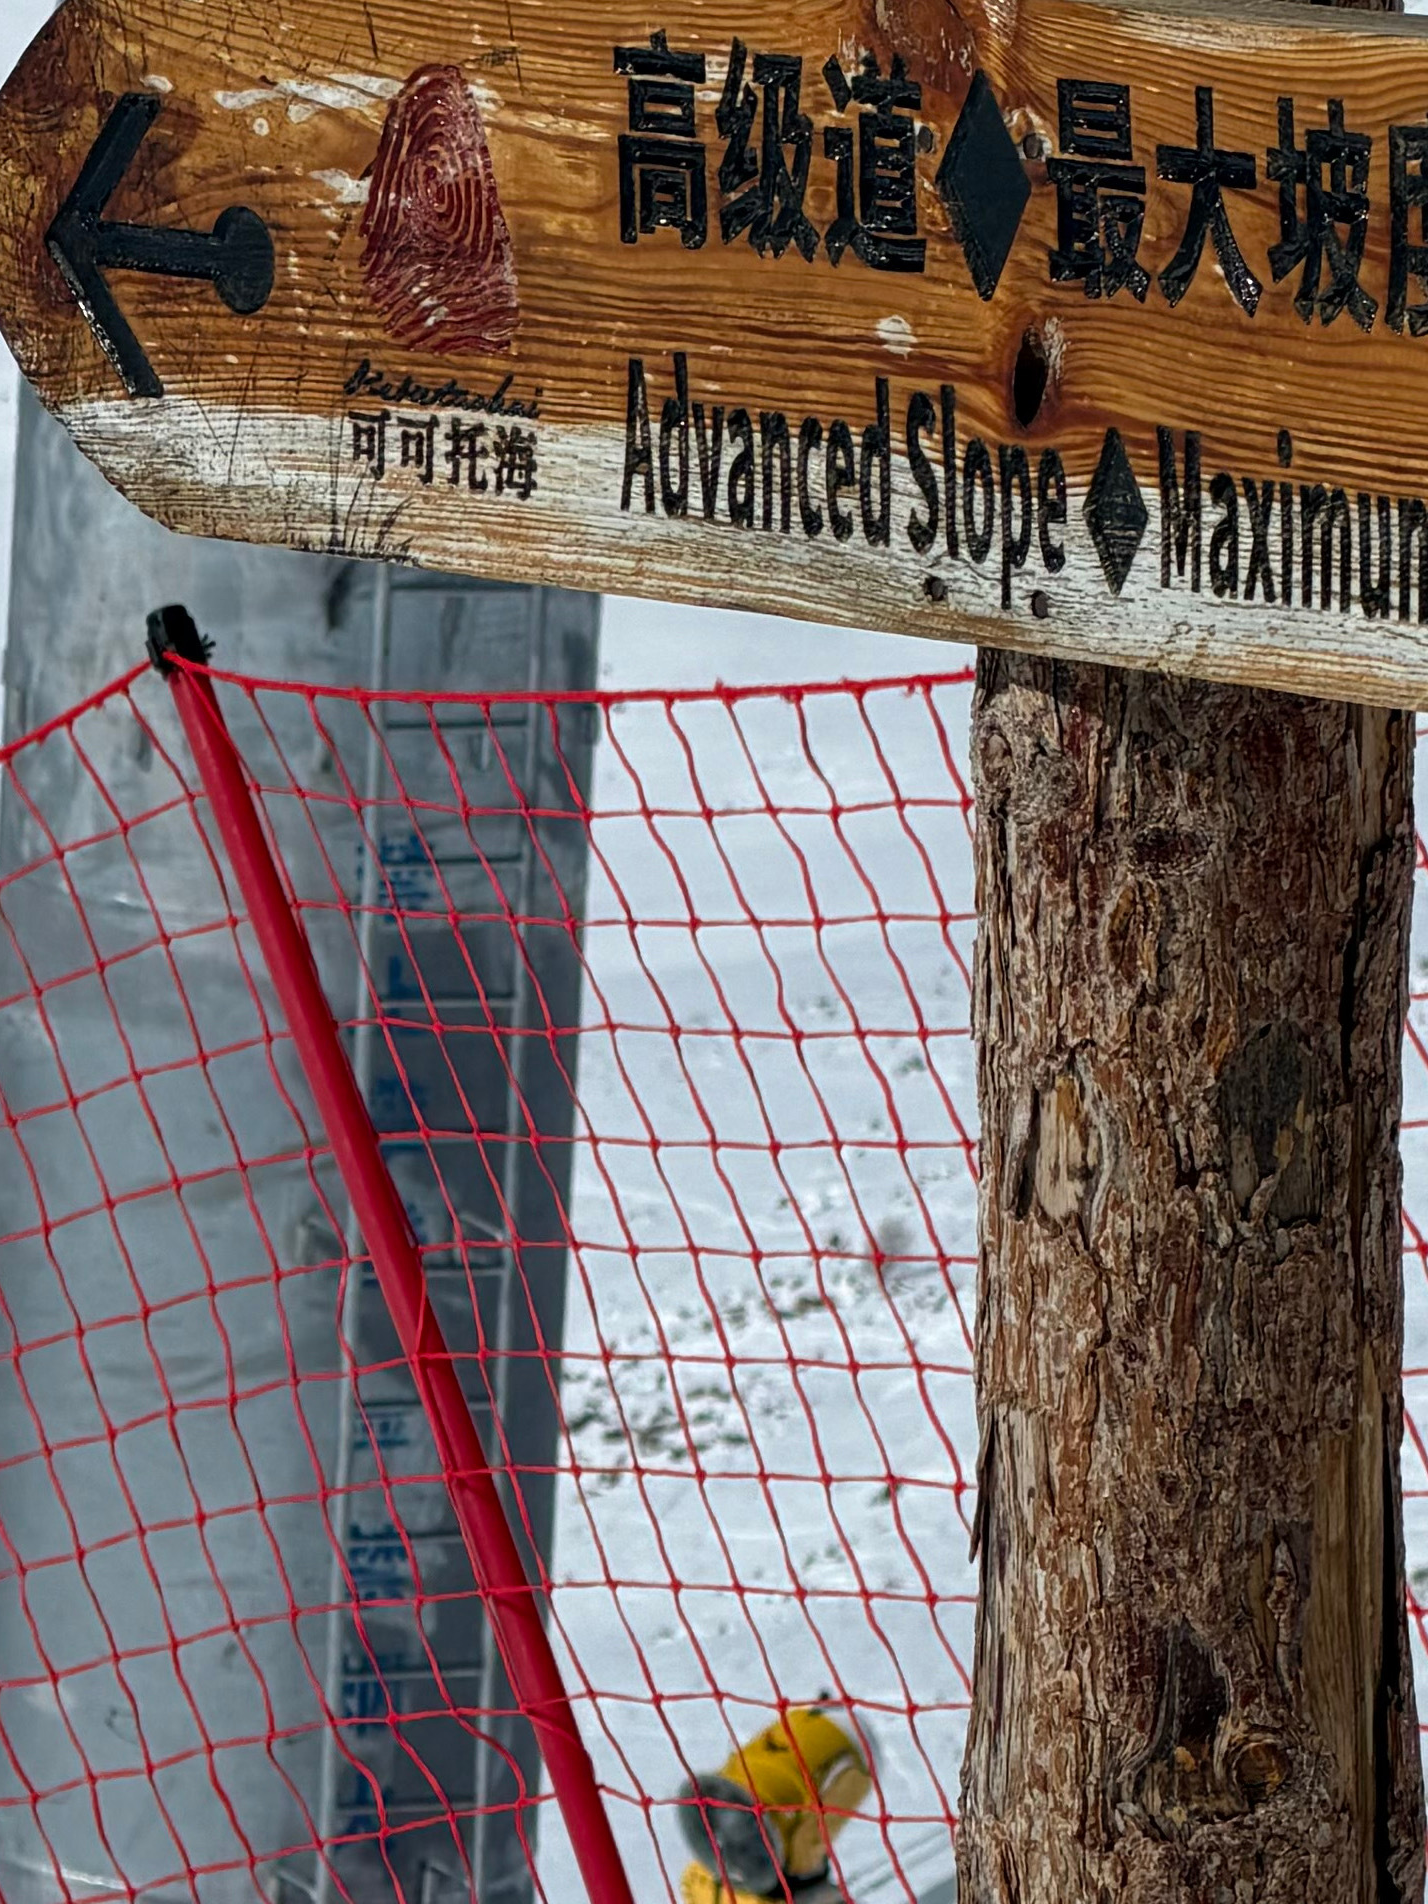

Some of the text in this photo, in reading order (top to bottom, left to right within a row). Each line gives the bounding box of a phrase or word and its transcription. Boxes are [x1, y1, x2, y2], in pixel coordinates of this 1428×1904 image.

[613, 30, 929, 273] 高级道
[348, 408, 538, 501] 可可托海
[621, 352, 896, 547] Advanced
[905, 383, 1068, 611] Slope
